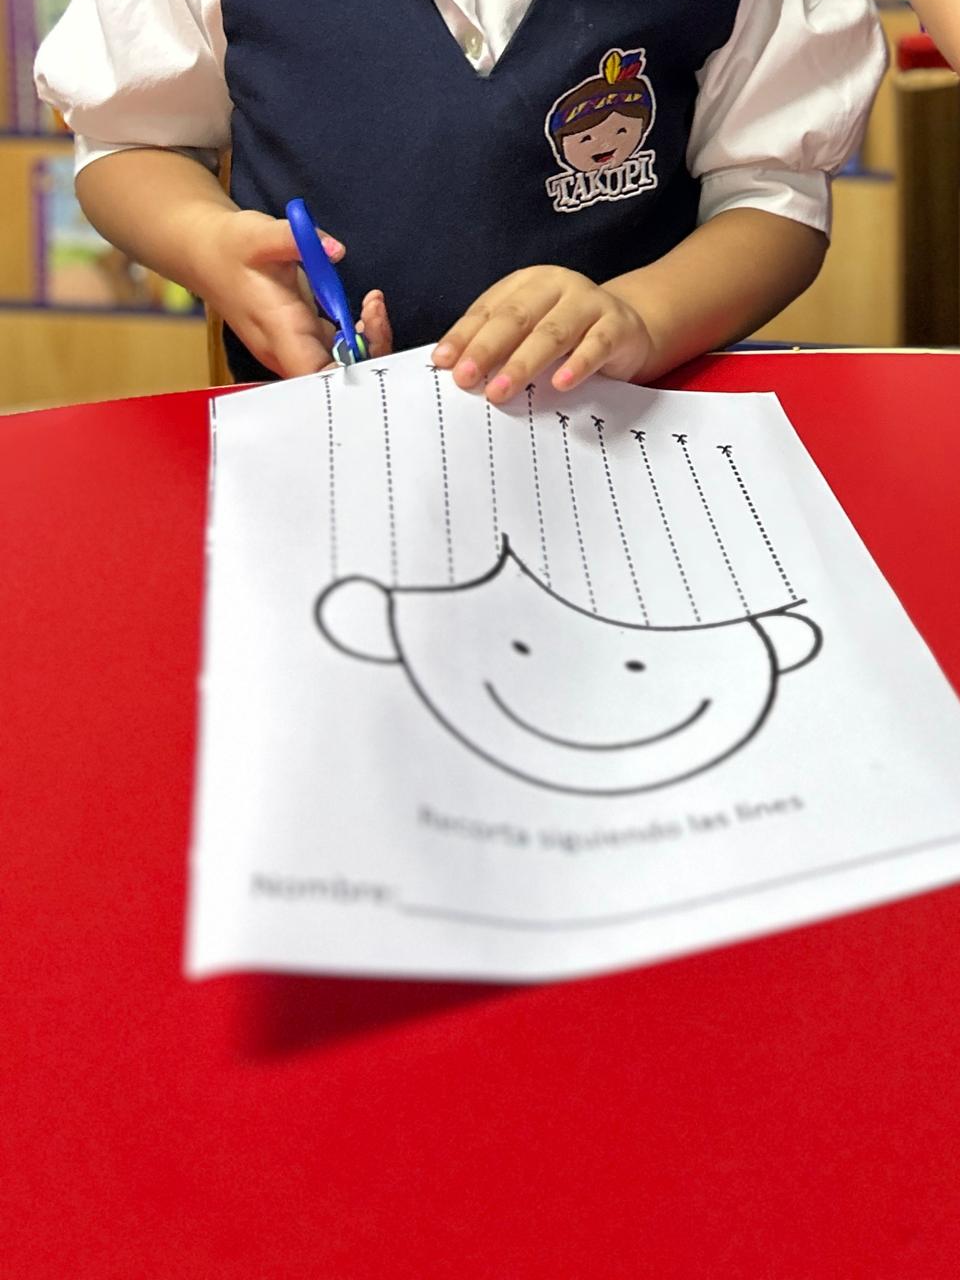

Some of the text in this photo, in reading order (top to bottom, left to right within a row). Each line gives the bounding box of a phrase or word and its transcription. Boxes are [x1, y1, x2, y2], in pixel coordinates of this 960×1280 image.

[550, 156, 653, 206] TAKUPI
[416, 803, 531, 849] Recorta
[686, 813, 731, 833] las
